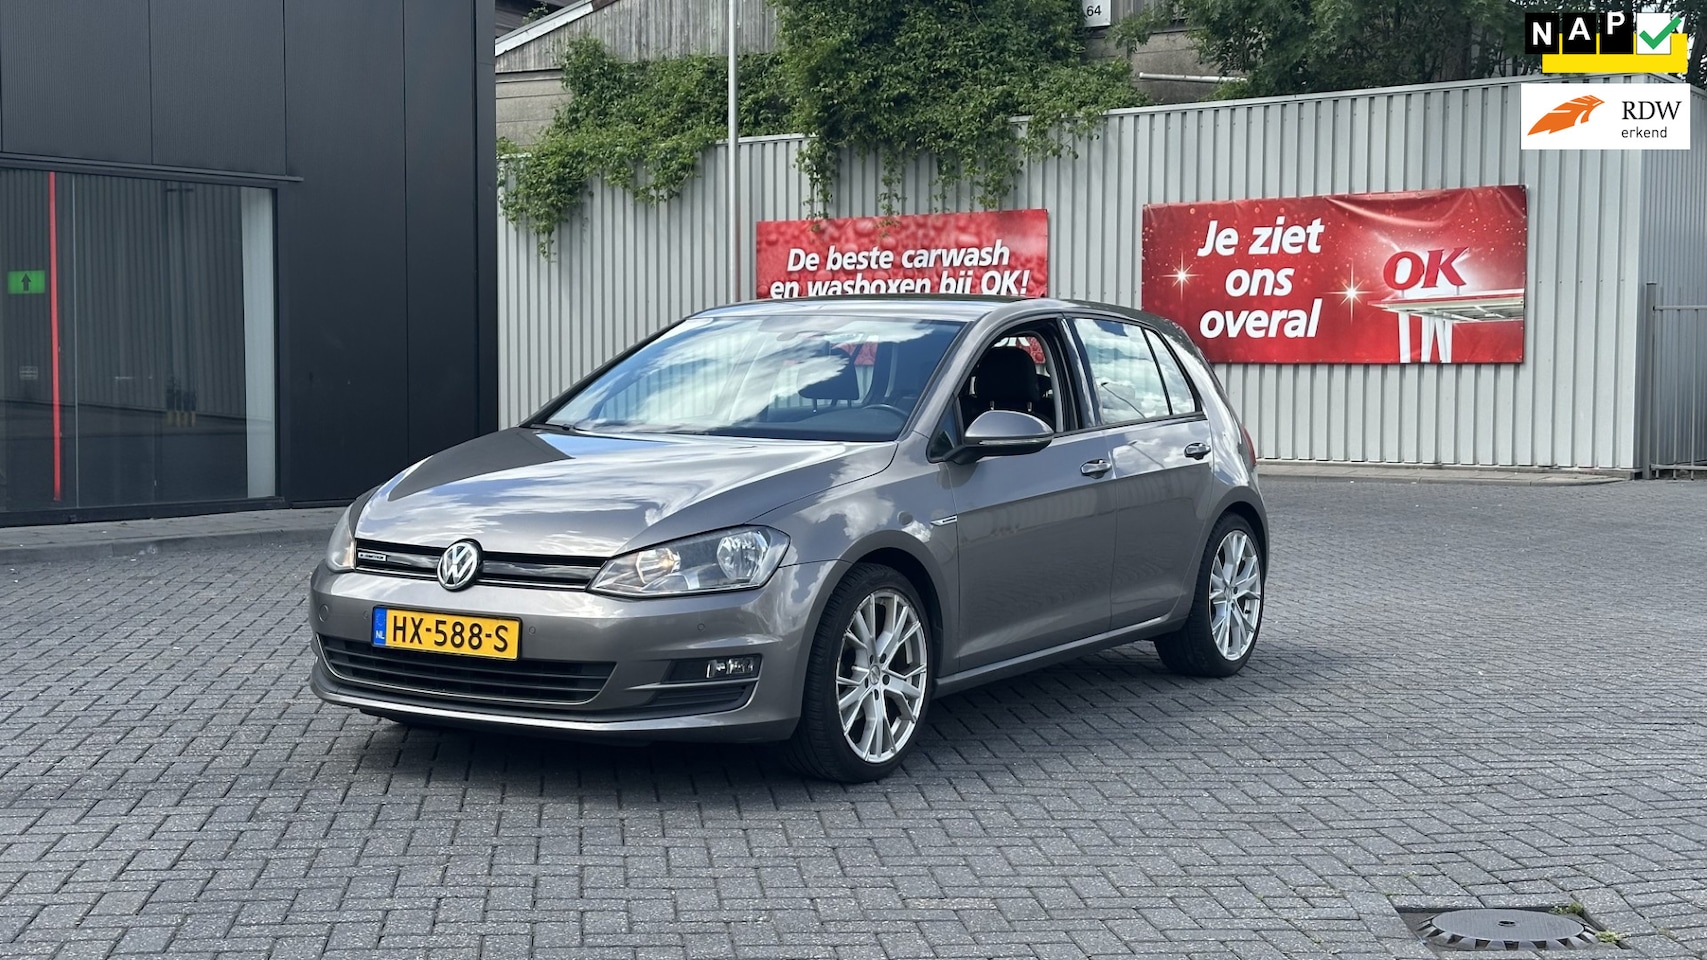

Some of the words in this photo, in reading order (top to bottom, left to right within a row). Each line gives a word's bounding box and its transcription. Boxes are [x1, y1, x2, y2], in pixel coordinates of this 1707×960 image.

[1086, 5, 1102, 17] 64
[1197, 220, 1239, 257] Je
[1248, 216, 1325, 255] ziet
[787, 248, 819, 272] De
[826, 245, 893, 271] beste
[901, 239, 1010, 269] carwash
[1382, 247, 1469, 291] OK
[770, 280, 799, 299] en
[981, 269, 1031, 295] OK!
[1225, 267, 1295, 297] ons
[1199, 298, 1323, 339] overal
[375, 630, 385, 639] NL
[393, 615, 509, 653] HX-588-S
